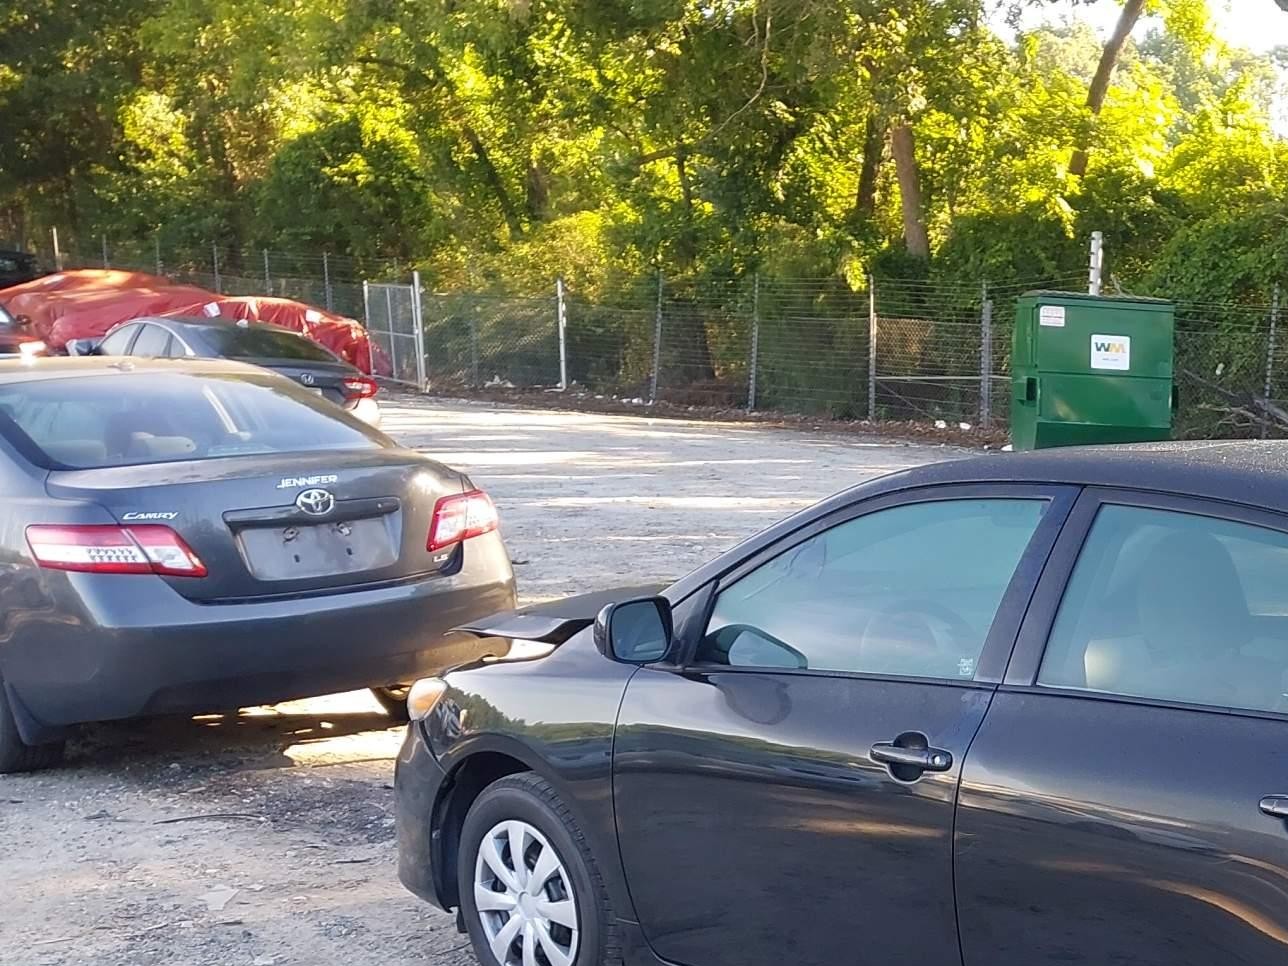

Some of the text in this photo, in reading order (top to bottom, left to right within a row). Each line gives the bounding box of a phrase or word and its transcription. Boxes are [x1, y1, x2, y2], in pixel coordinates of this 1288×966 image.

[1094, 341, 1127, 353] WM
[276, 475, 338, 489] JENNIFER
[122, 511, 179, 520] CAMRY
